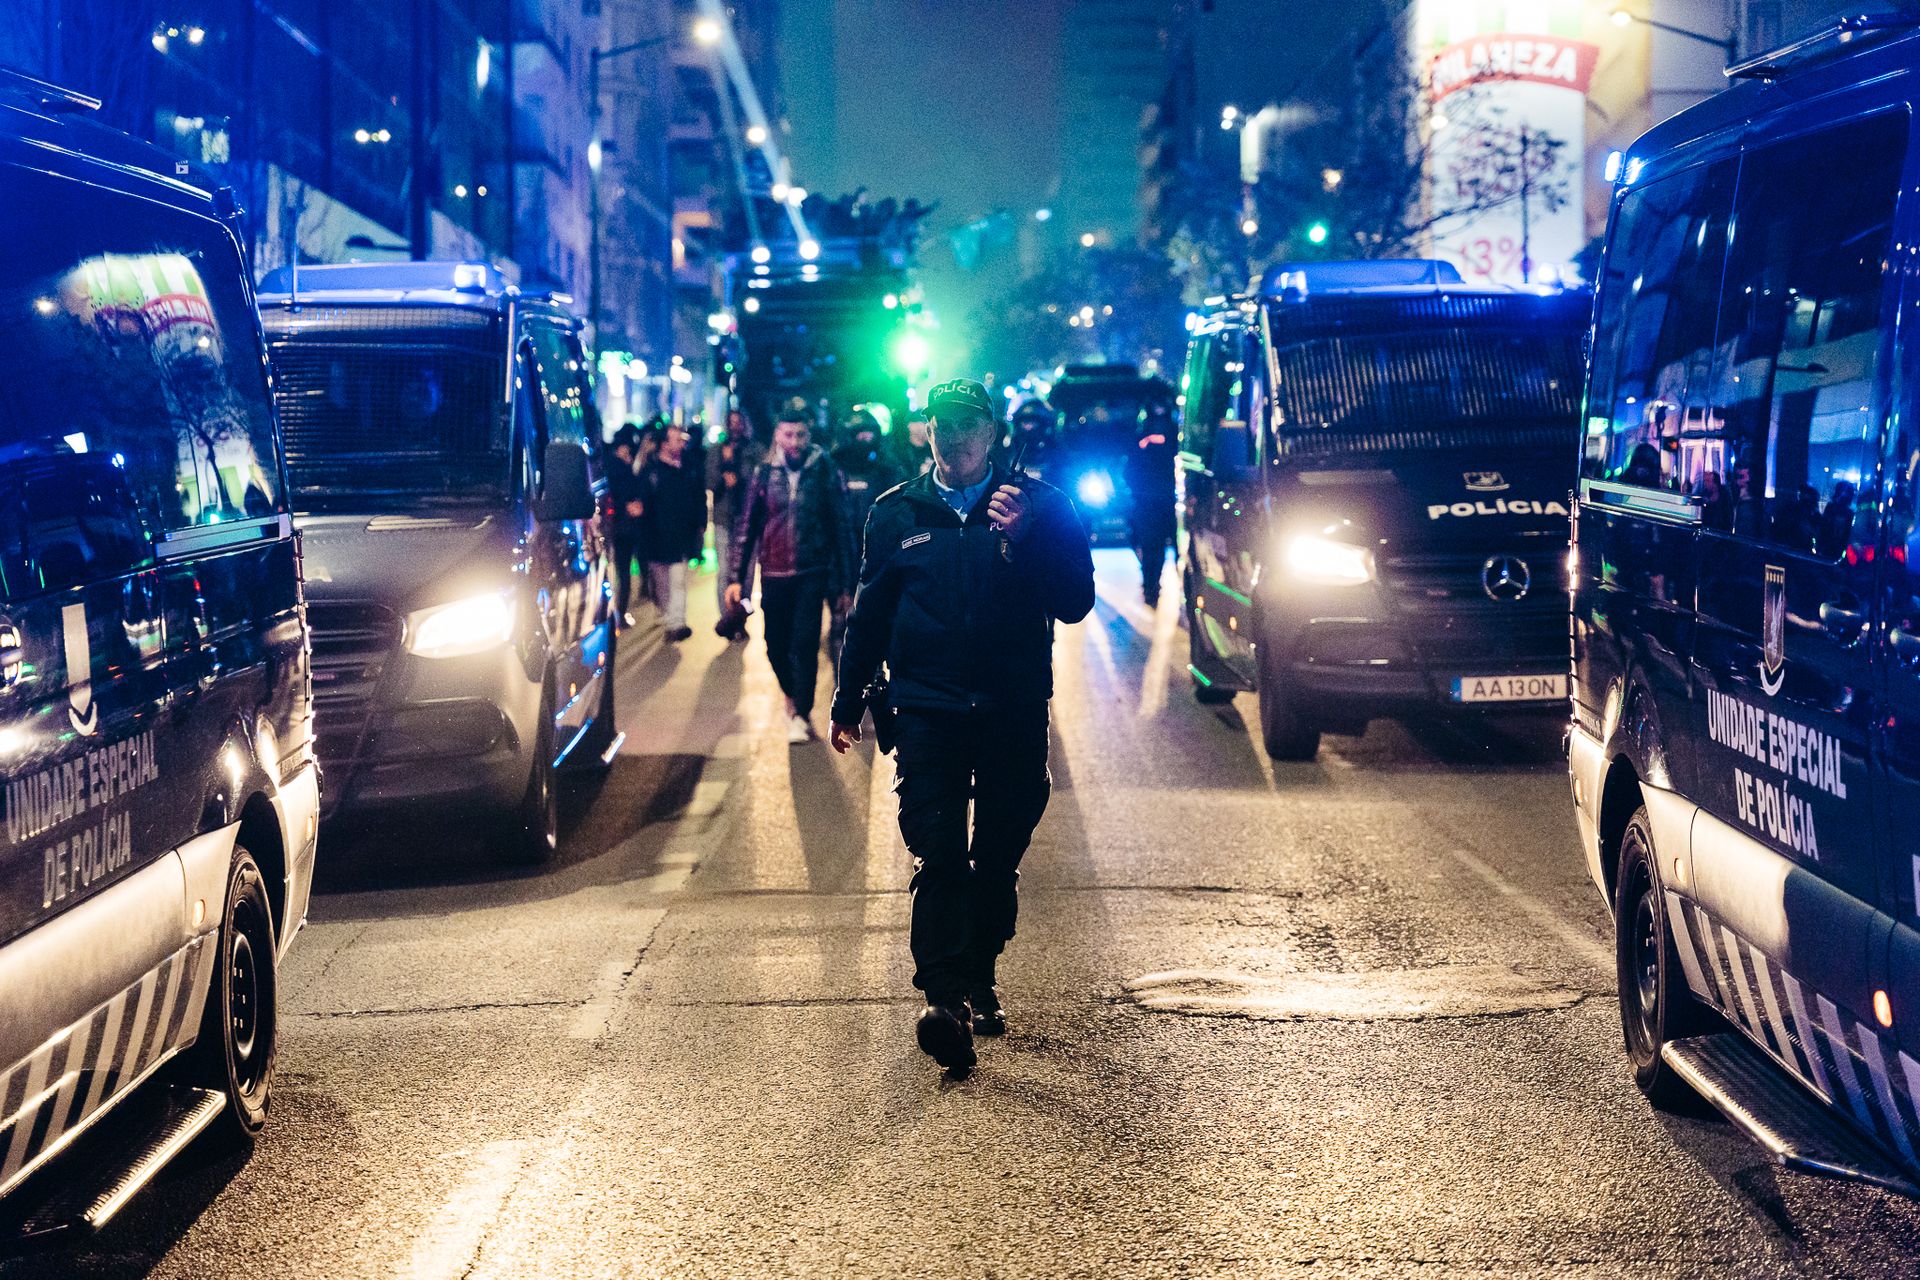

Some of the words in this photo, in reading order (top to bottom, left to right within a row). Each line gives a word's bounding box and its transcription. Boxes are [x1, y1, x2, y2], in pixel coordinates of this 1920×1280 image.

[1427, 498, 1569, 520] POLÍCIA
[6, 757, 86, 844] UNIDADE
[89, 730, 159, 808] ESPECIAL
[1707, 688, 1766, 763] UNIDADE
[1768, 712, 1847, 800] ESPECIAL
[42, 839, 67, 908] DE
[70, 806, 131, 893] POLÍCIA
[1734, 767, 1756, 827] DE
[1755, 779, 1819, 861] POLÍCIA
